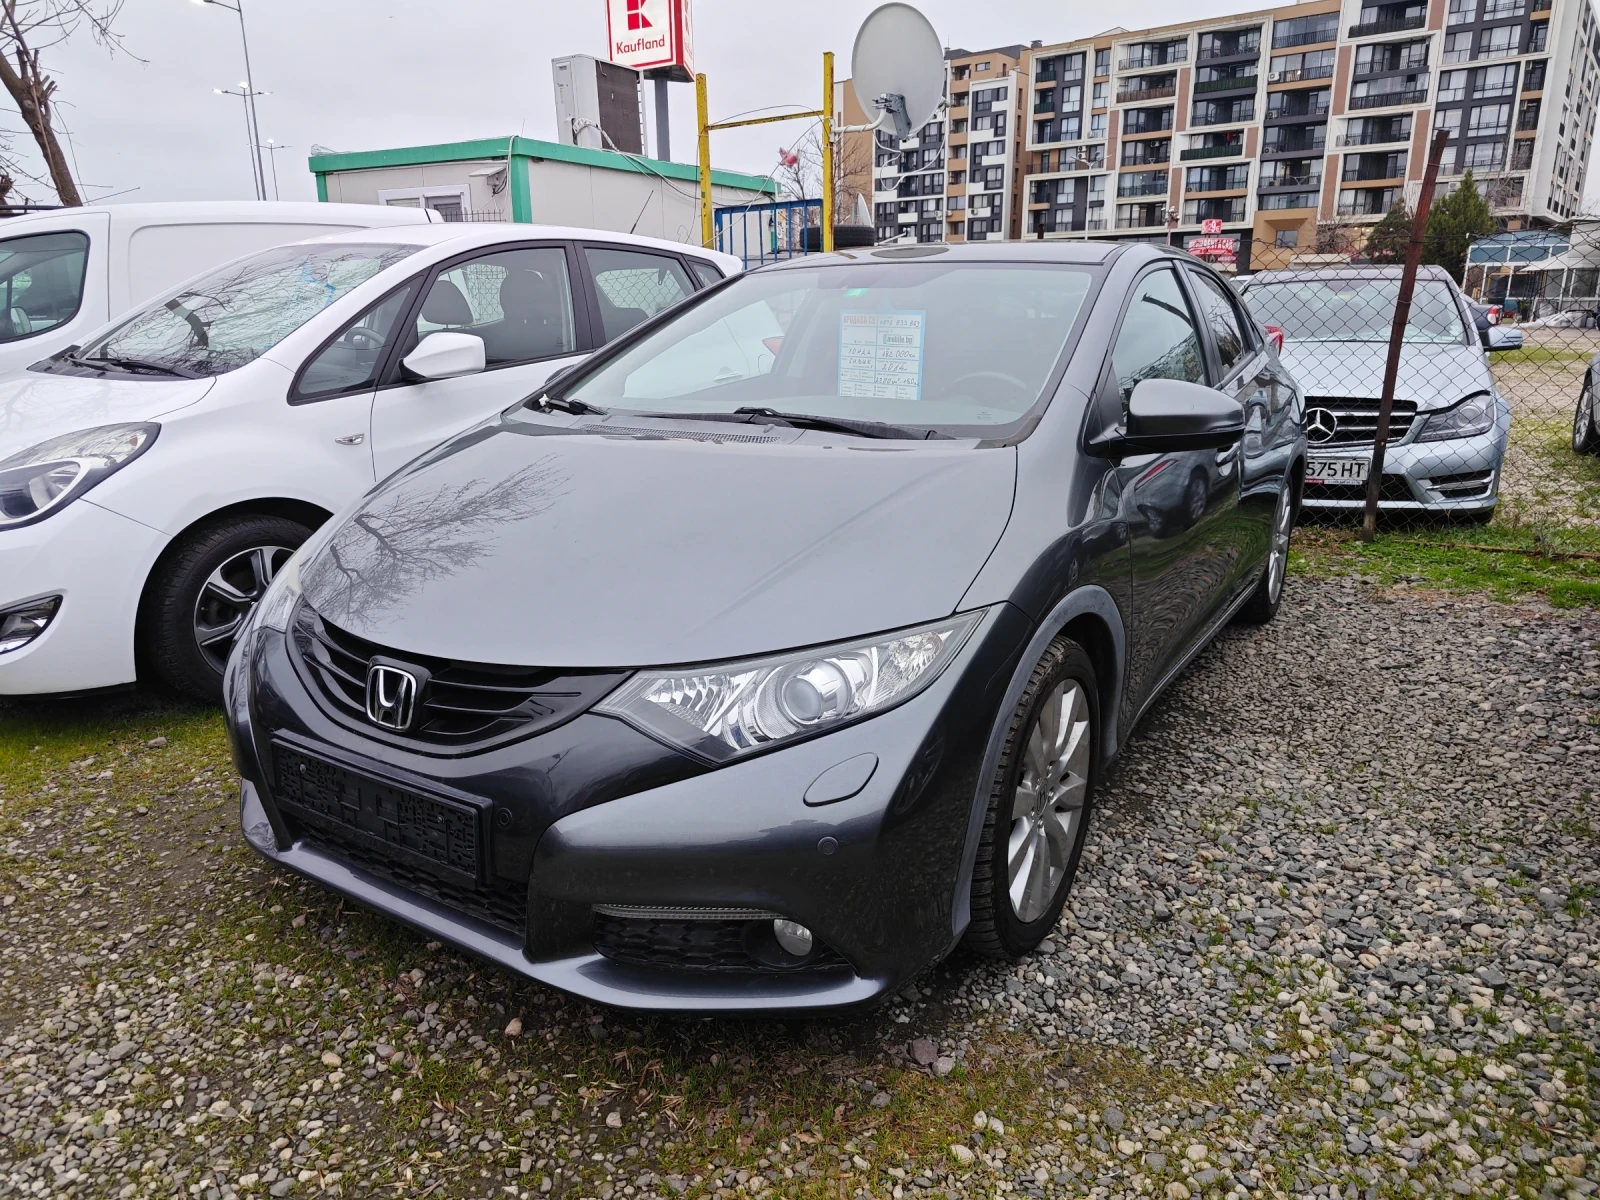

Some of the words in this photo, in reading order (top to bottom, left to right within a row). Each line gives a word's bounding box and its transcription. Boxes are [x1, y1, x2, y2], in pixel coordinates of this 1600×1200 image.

[616, 33, 665, 54] Kaufland
[868, 316, 876, 325] СЕ
[887, 336, 913, 344] mobile.bg
